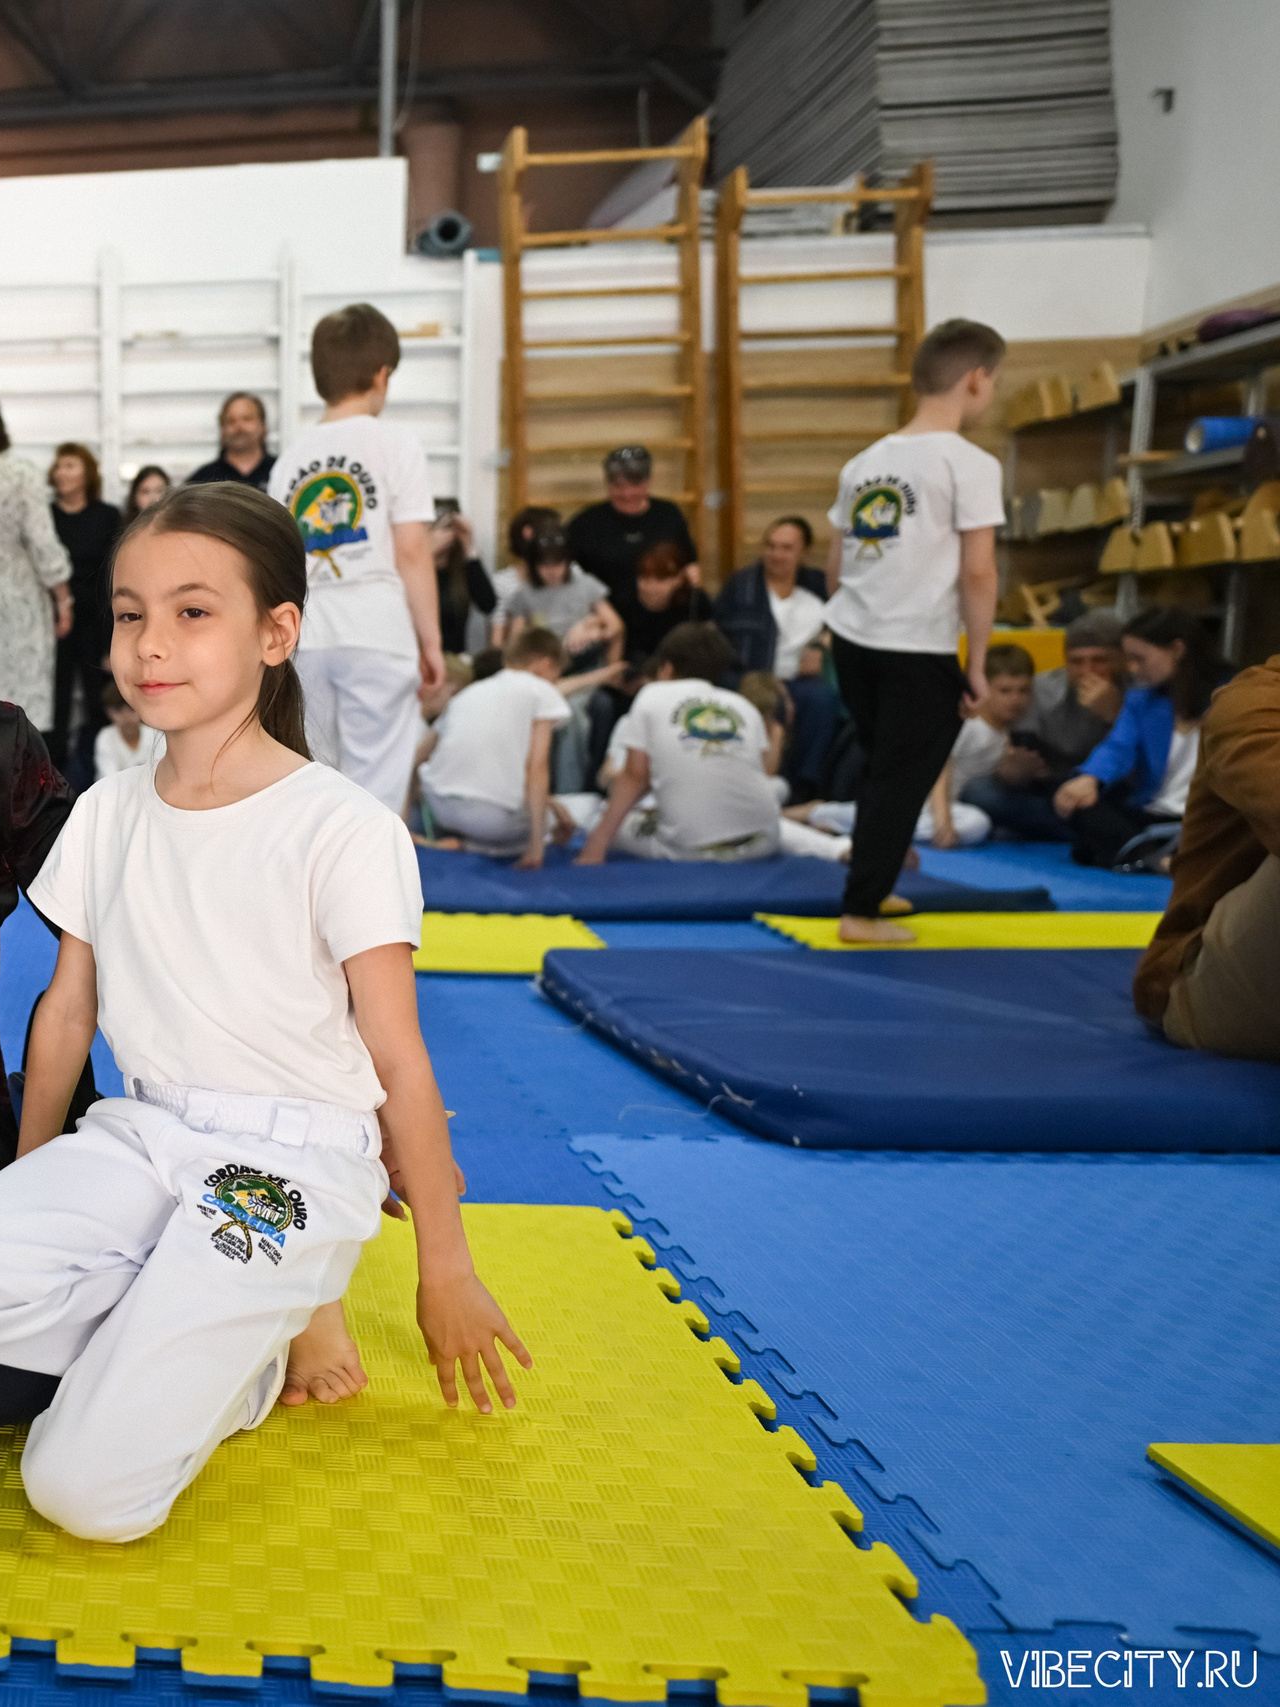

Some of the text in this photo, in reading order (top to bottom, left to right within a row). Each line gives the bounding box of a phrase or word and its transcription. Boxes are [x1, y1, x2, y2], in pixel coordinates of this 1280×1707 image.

[349, 462, 378, 511] OURO
[201, 1193, 286, 1248] CAPOEIRA
[288, 1189, 308, 1231] OURO
[213, 1244, 235, 1261] RUSSIA
